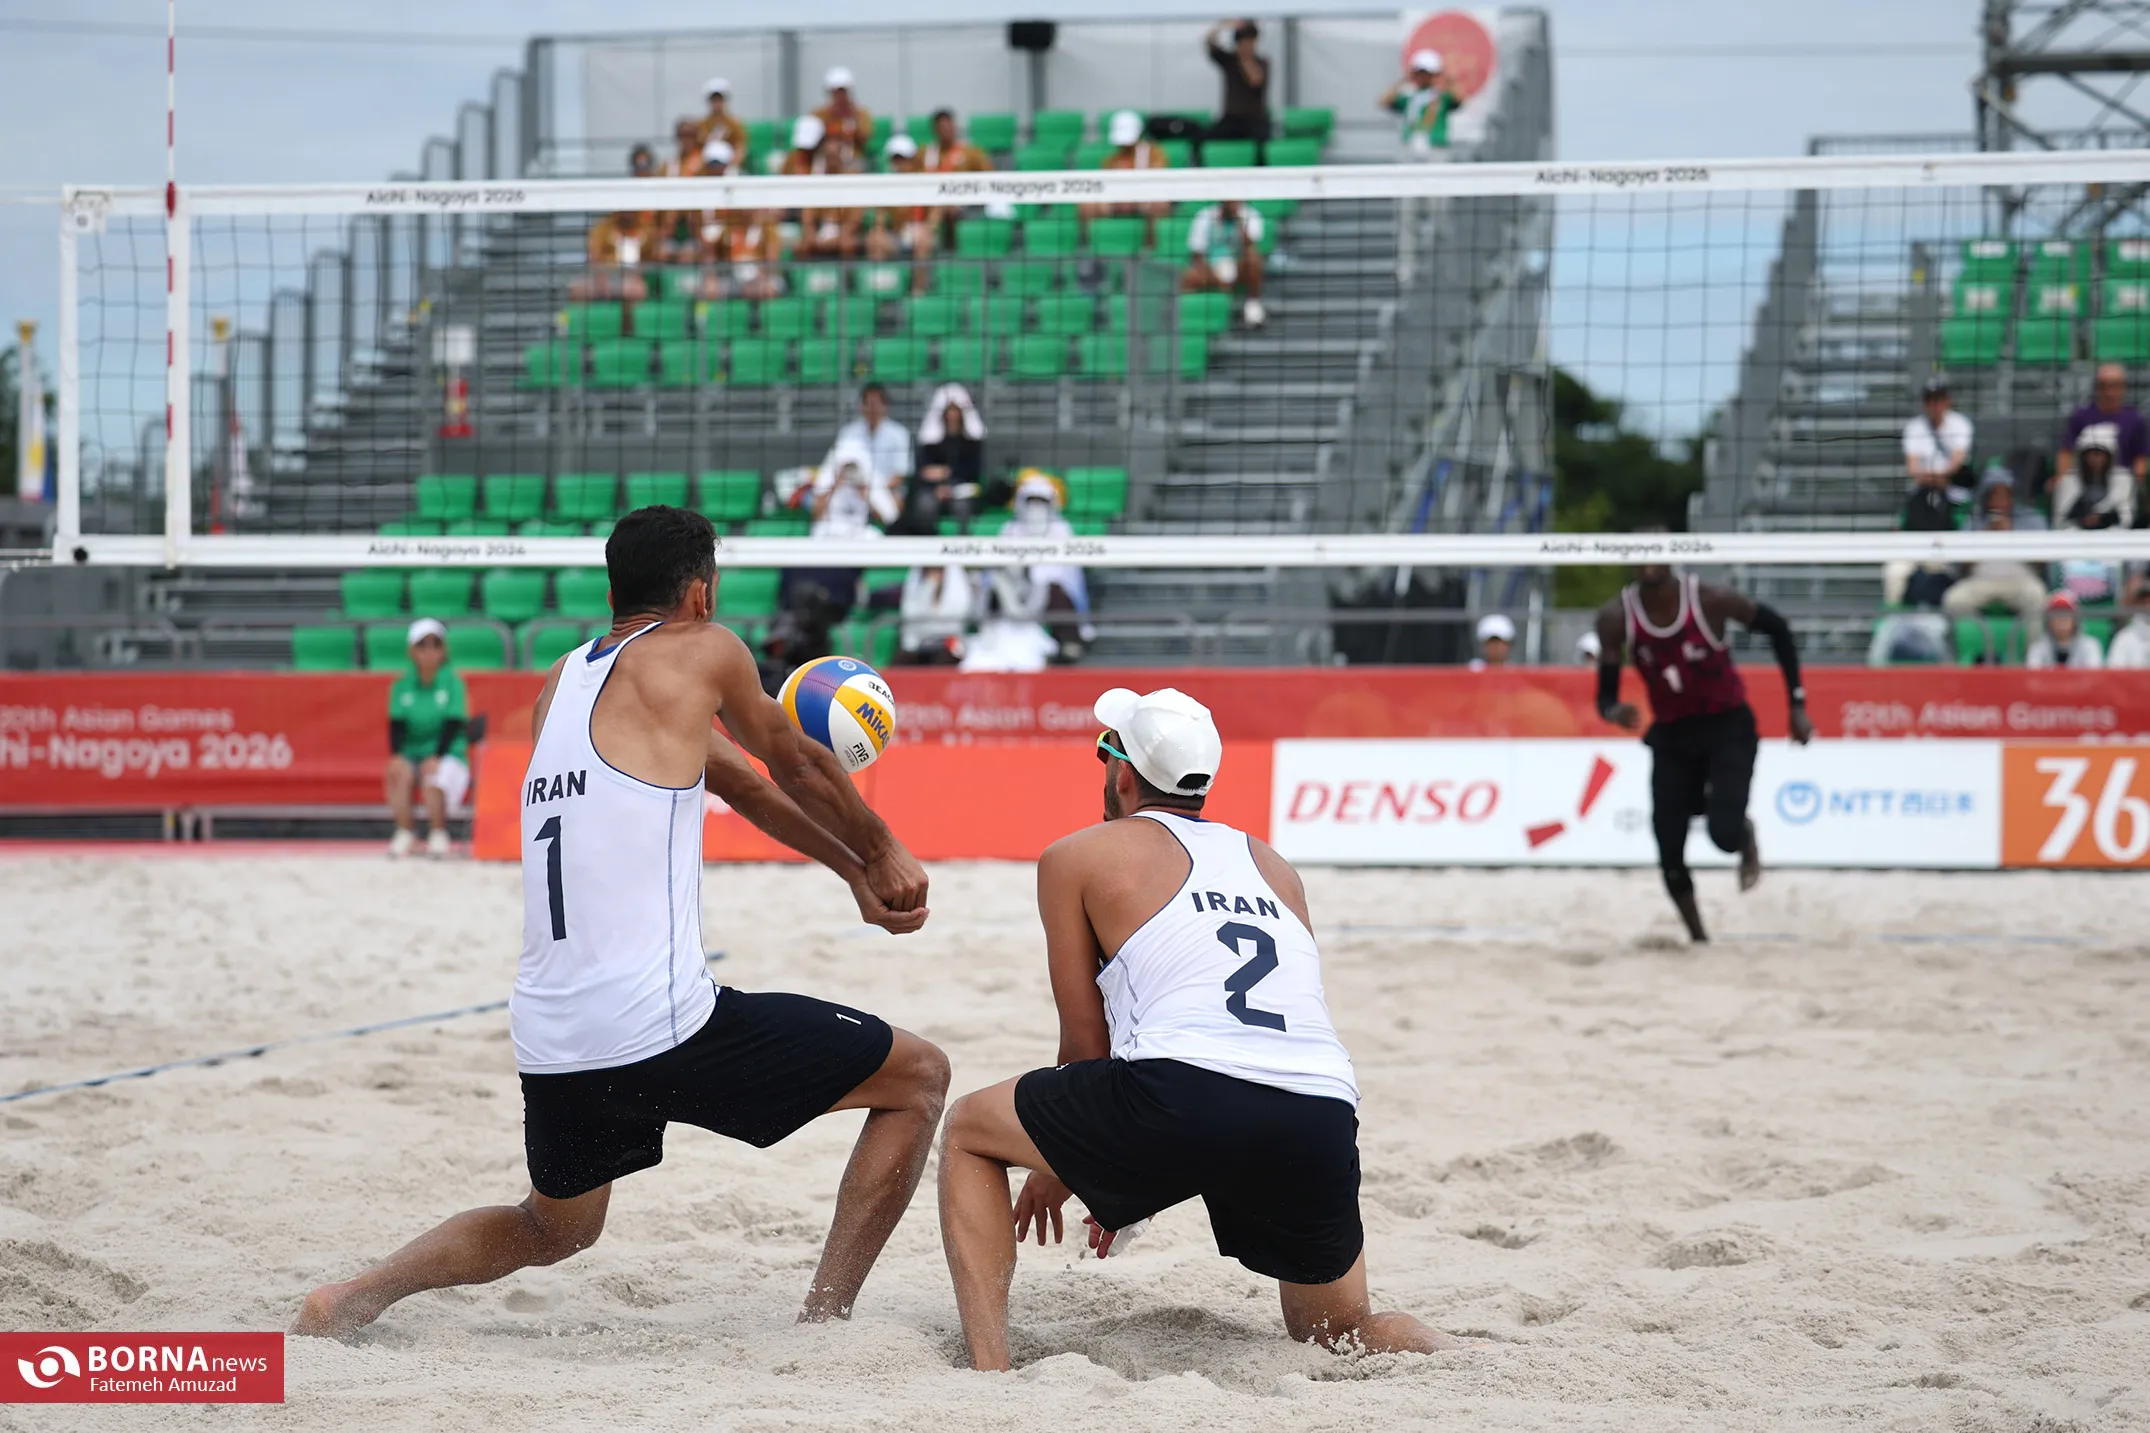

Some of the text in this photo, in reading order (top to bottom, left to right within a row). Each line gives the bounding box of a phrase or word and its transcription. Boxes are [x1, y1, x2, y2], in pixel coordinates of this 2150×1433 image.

[938, 179, 1104, 198] Aichi-Nagoya 2026
[1535, 166, 1711, 187] Aichi-Nagoya 2026
[366, 188, 526, 207] Aichi-Nagoya 2026
[62, 703, 135, 732] Asian
[138, 703, 235, 732] Games
[955, 700, 1036, 731] Asian
[1840, 700, 2119, 731] 20th Asian Games
[197, 732, 293, 770] 2026
[526, 770, 587, 807] IRAN
[1286, 780, 1502, 824] DENSO
[533, 815, 567, 941] 1
[1191, 891, 1280, 920] IRAN
[1216, 921, 1287, 1032] 2
[836, 1012, 862, 1025] 1
